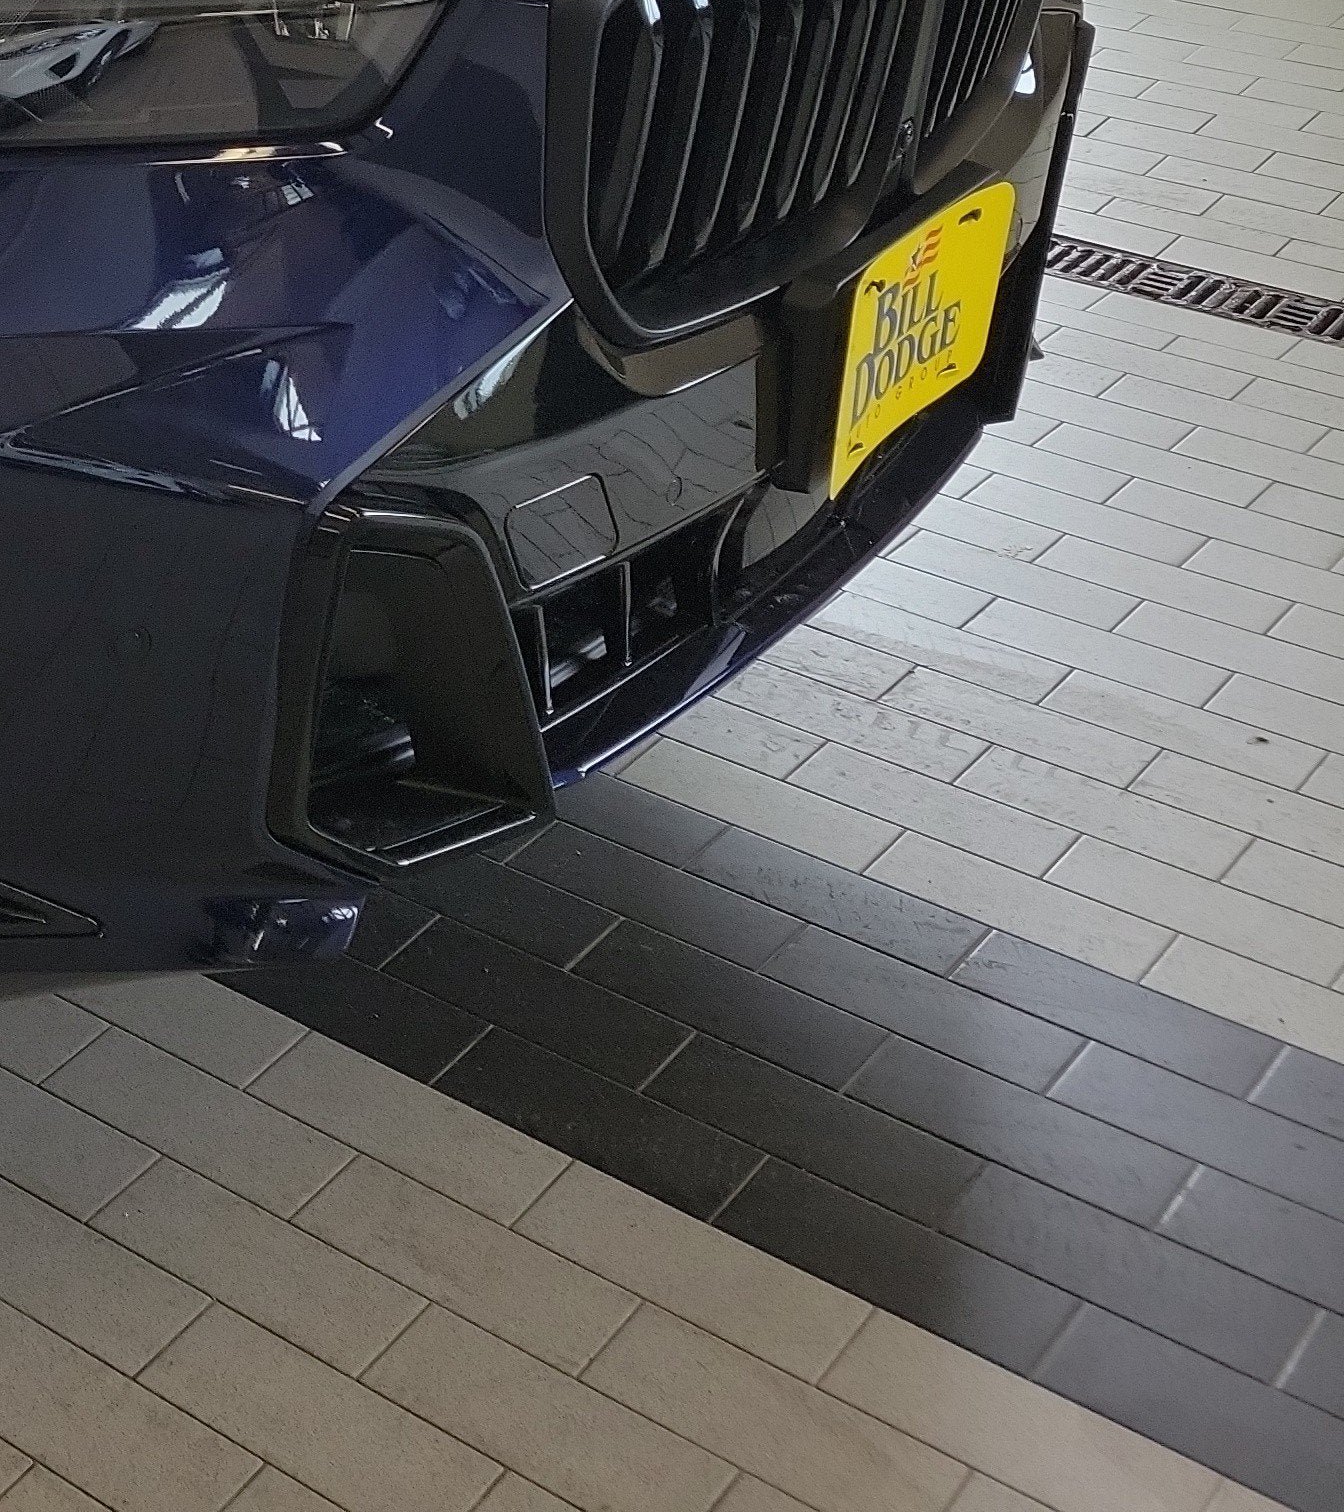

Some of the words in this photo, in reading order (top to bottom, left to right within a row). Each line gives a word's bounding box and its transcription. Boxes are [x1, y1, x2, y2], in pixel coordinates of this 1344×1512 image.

[873, 270, 945, 357] BILL
[850, 299, 962, 428] DODGE
[893, 348, 954, 401] GROUP
